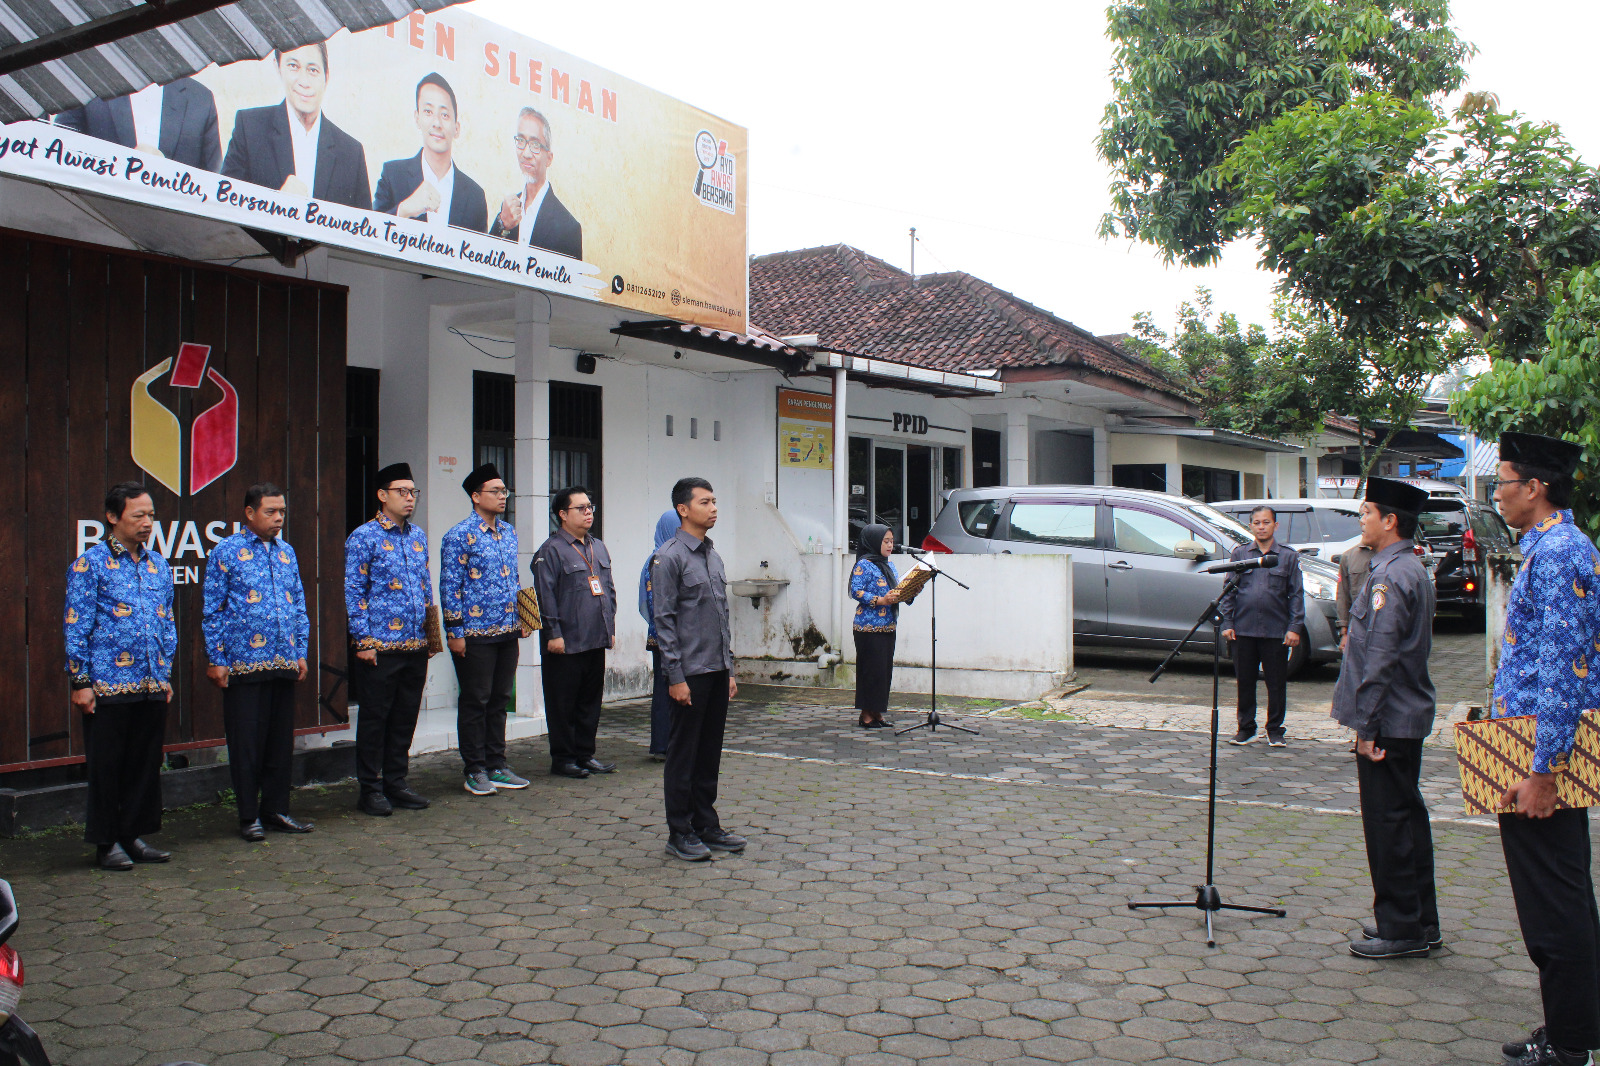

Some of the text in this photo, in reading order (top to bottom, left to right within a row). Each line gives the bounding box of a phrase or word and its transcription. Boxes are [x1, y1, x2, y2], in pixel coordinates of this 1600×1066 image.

[485, 42, 617, 123] SLEMAN
[720, 155, 733, 176] AYO
[710, 169, 733, 193] AWASI
[702, 182, 733, 209] BERSAMA
[45, 138, 118, 177] Awasi
[125, 156, 208, 203] Pemilu,
[216, 179, 301, 221] Bersama
[305, 202, 379, 239] Bawaslu
[384, 220, 456, 259] Tegakkan
[459, 240, 521, 274] Keadilan
[525, 256, 572, 285] Pemilu
[893, 412, 928, 435] PPID
[438, 455, 458, 466] PPID
